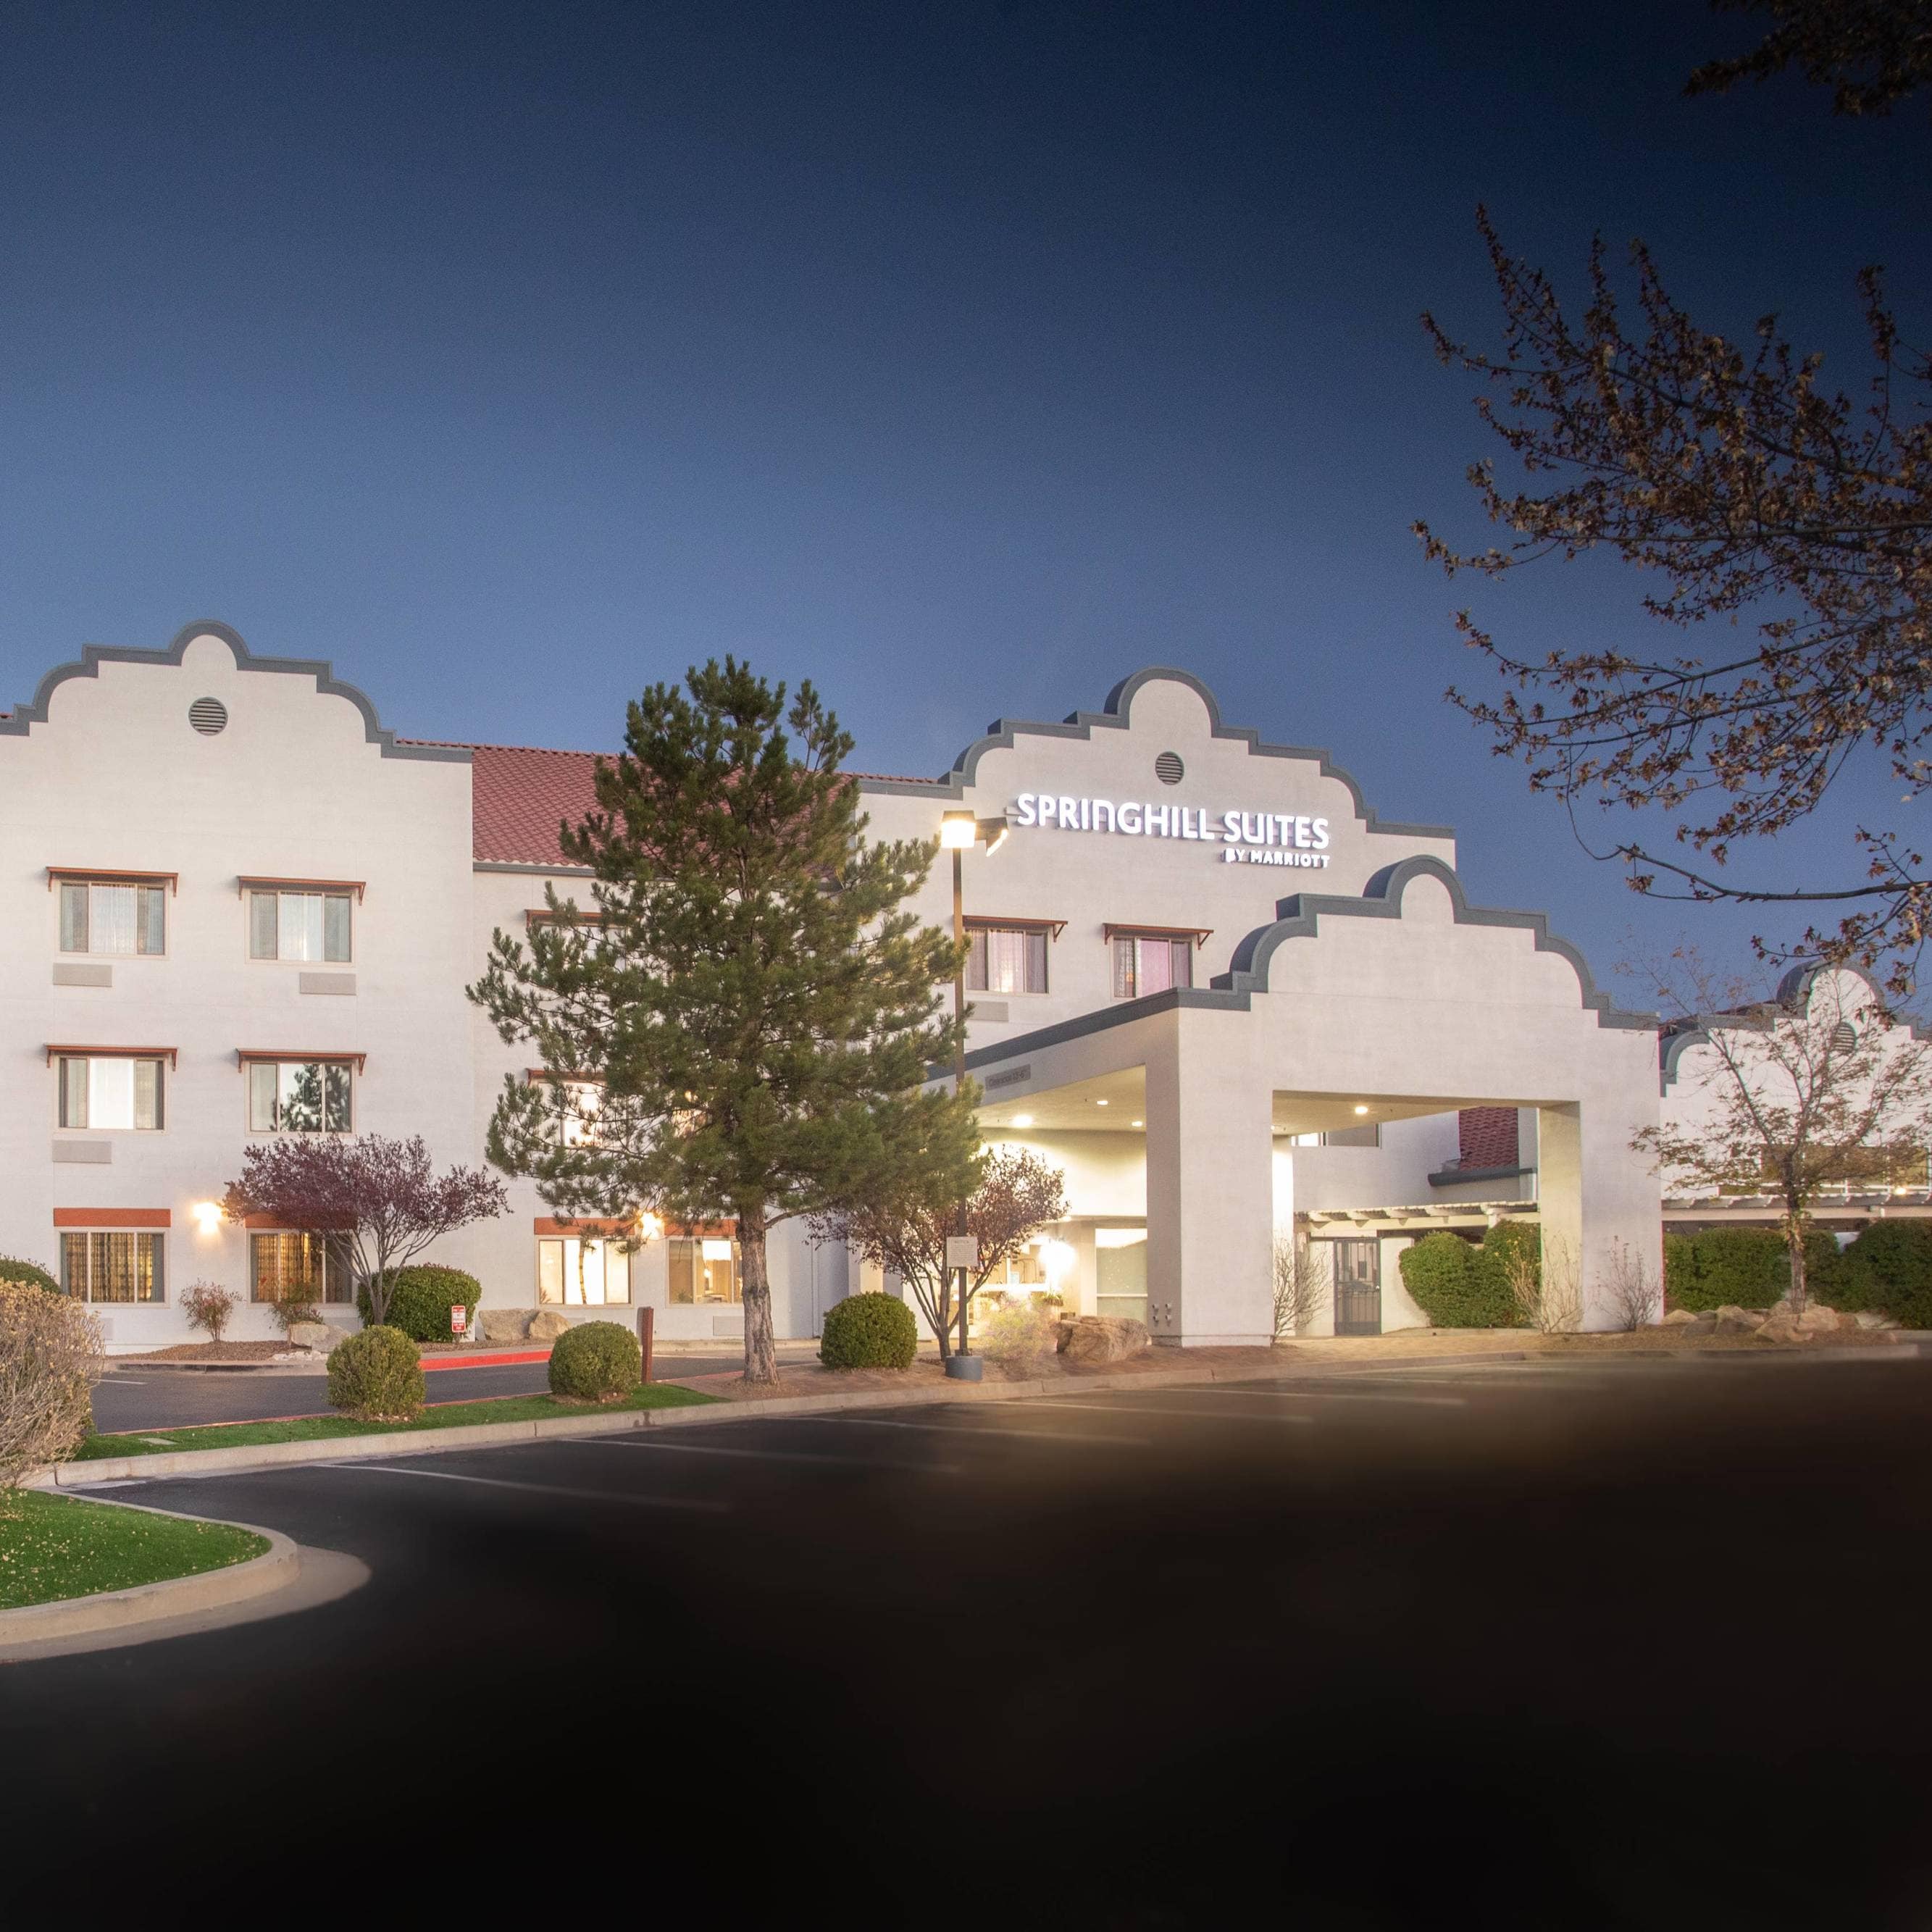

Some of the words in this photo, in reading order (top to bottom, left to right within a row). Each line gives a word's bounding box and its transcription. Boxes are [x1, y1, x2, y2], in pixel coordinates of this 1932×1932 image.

[1017, 793, 1215, 840] SPRINGHILL
[1223, 811, 1329, 849] SUITES
[1225, 848, 1245, 863] BY
[1250, 850, 1330, 868] MARRIOTT
